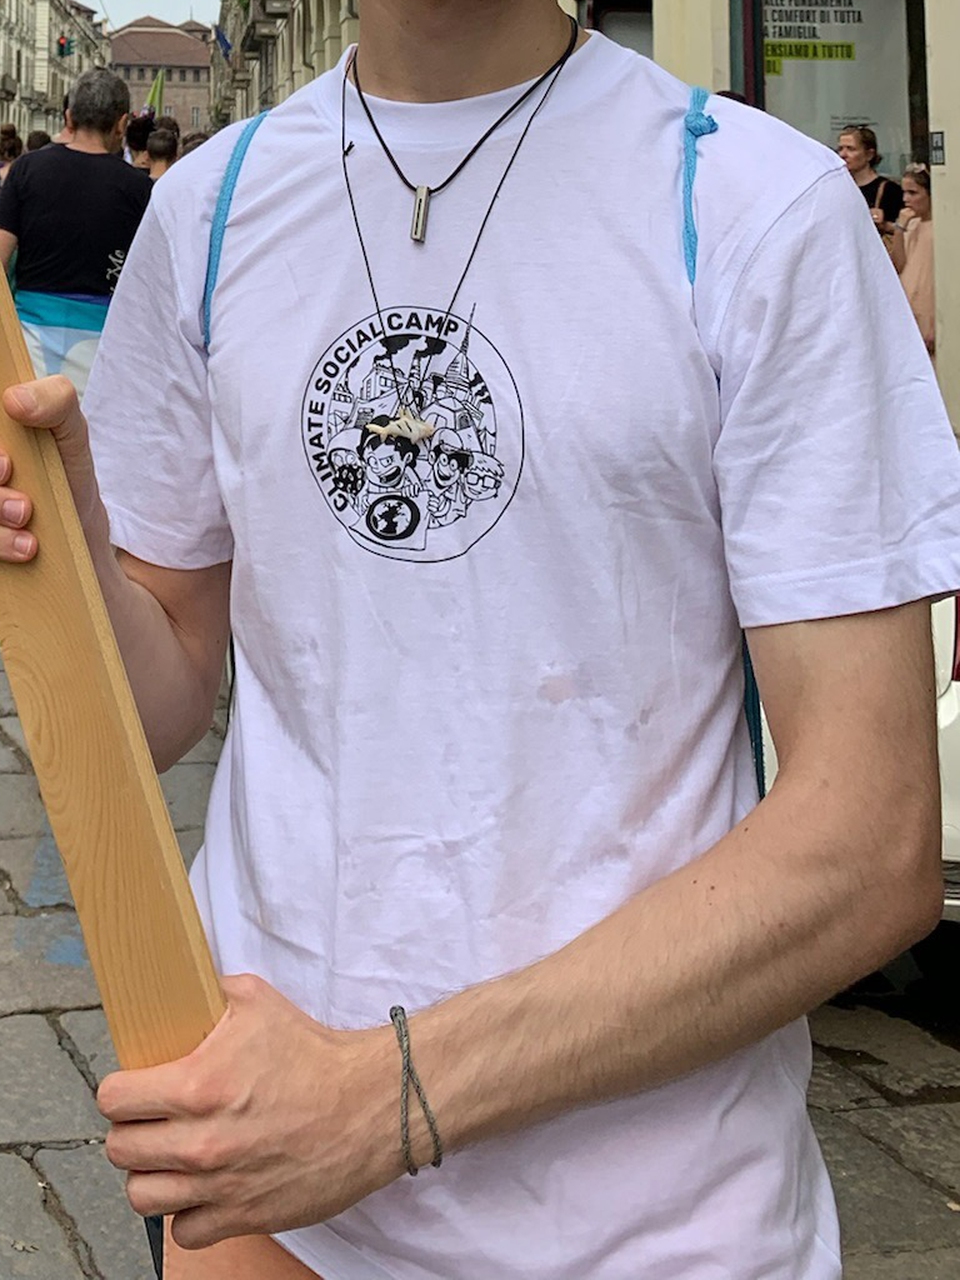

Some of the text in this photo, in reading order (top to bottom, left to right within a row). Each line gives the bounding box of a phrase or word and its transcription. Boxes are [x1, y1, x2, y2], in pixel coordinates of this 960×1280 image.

[771, 10, 817, 23] COMFORT
[820, 10, 830, 23] DI
[834, 10, 863, 24] TUTTA
[765, 43, 853, 59] ENSIAMO A TUTTO
[308, 311, 459, 512] CLIMATE SOCIAL CAMP
